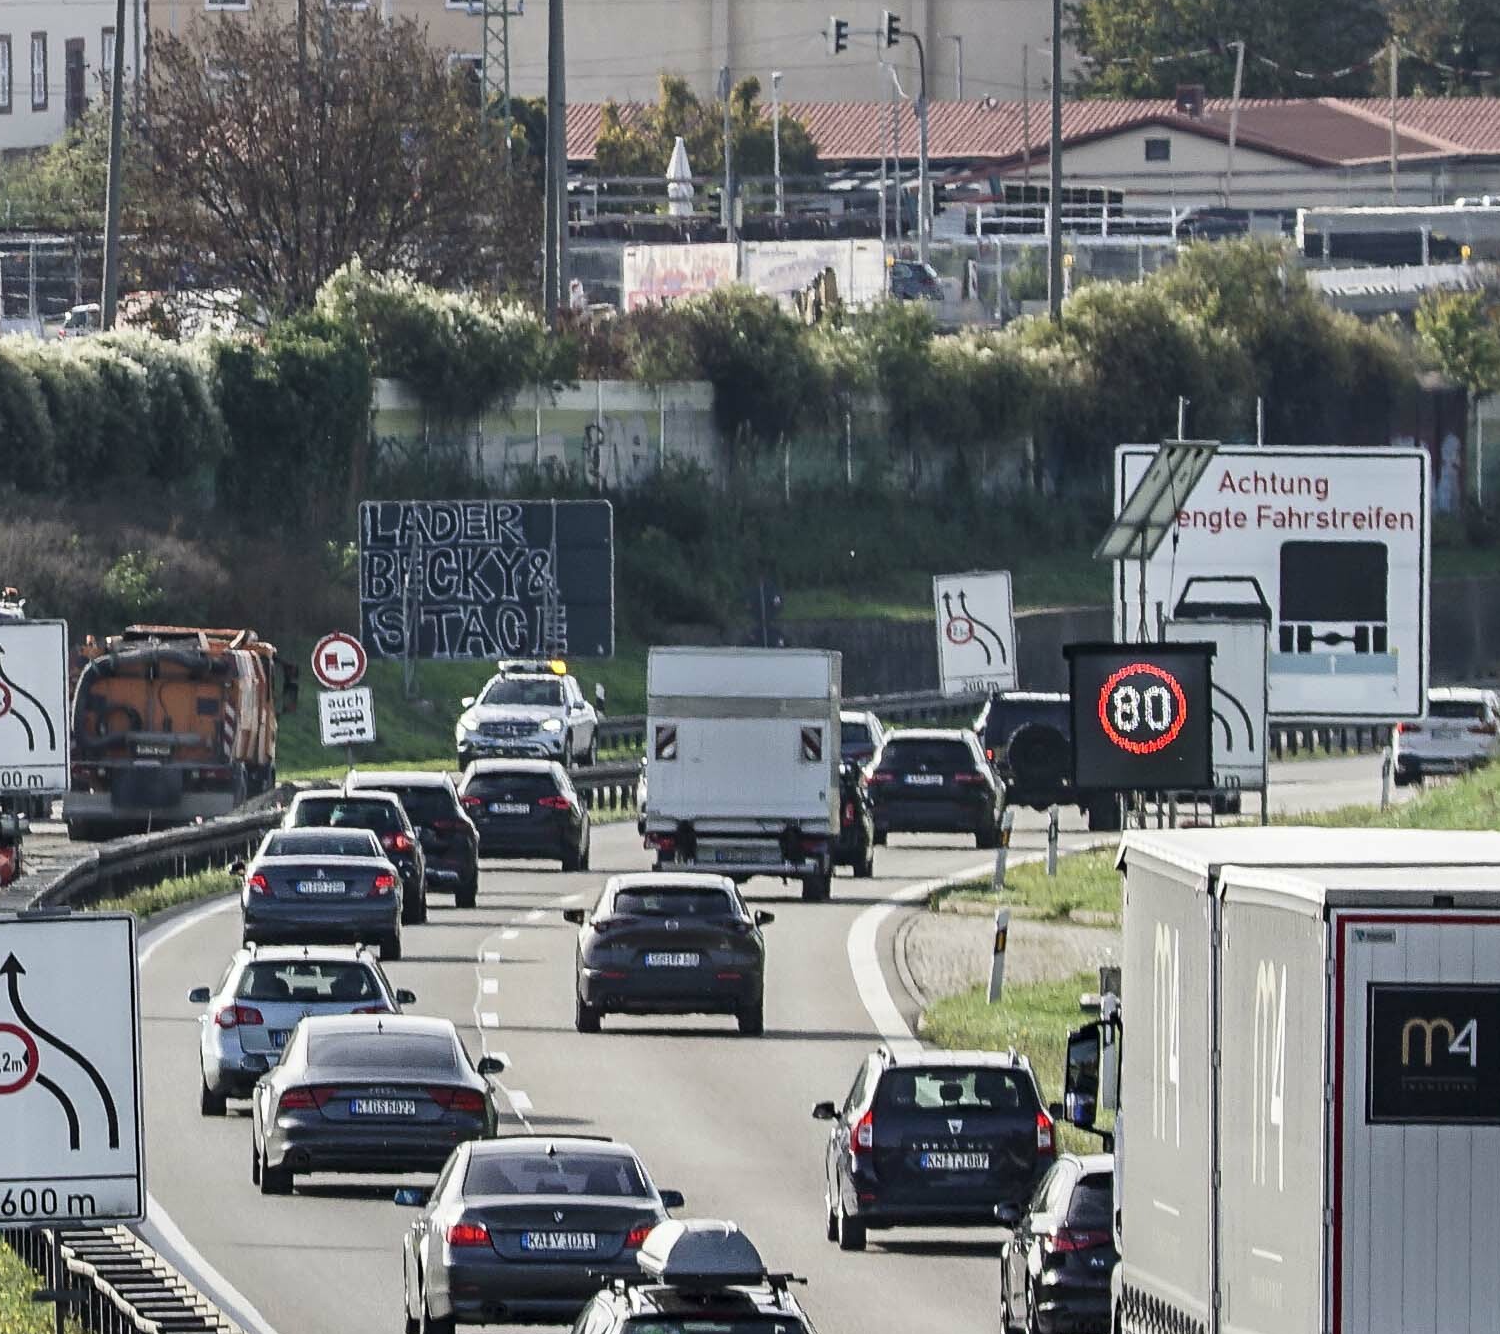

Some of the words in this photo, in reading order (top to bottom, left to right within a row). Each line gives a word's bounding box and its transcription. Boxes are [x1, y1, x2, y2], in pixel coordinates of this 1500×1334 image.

[1218, 469, 1330, 500] Achtung
[366, 503, 527, 546] LADER
[1176, 507, 1247, 534] engte
[1256, 504, 1415, 531] Fahrstreifen
[327, 692, 364, 708] auch
[1113, 685, 1172, 732] 80
[33, 773, 45, 788] m
[0, 1187, 58, 1217] 600
[67, 1193, 96, 1217] m
